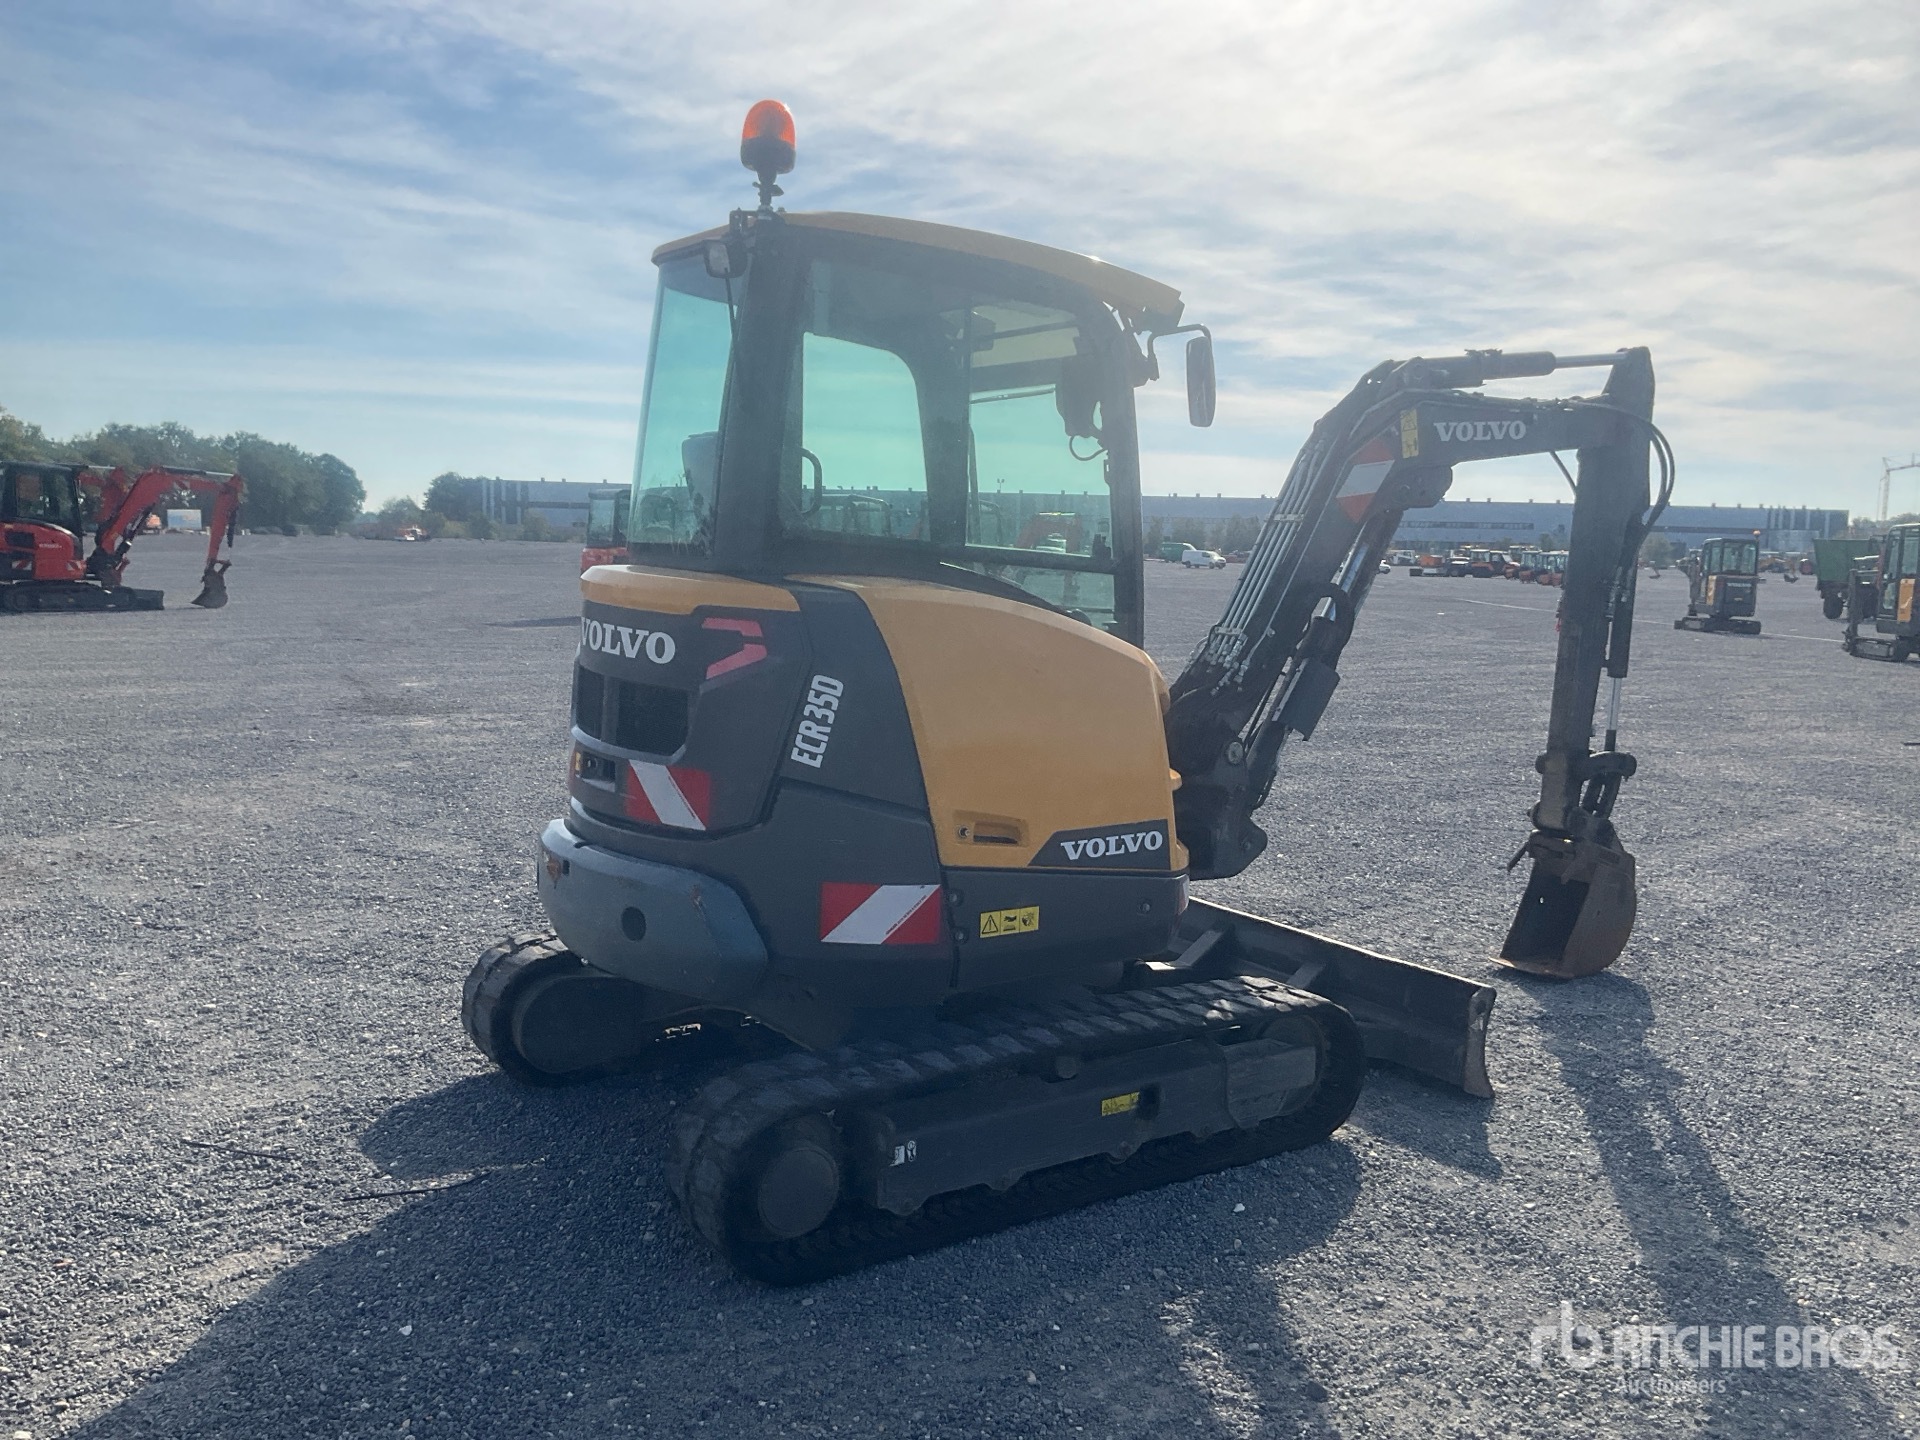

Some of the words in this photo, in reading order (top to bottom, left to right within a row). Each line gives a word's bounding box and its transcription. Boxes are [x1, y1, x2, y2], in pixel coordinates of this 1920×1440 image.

[1433, 420, 1527, 442] VOLVO
[581, 616, 676, 664] VOLVO
[790, 674, 845, 769] ECR35D
[1060, 830, 1164, 861] VOLVO
